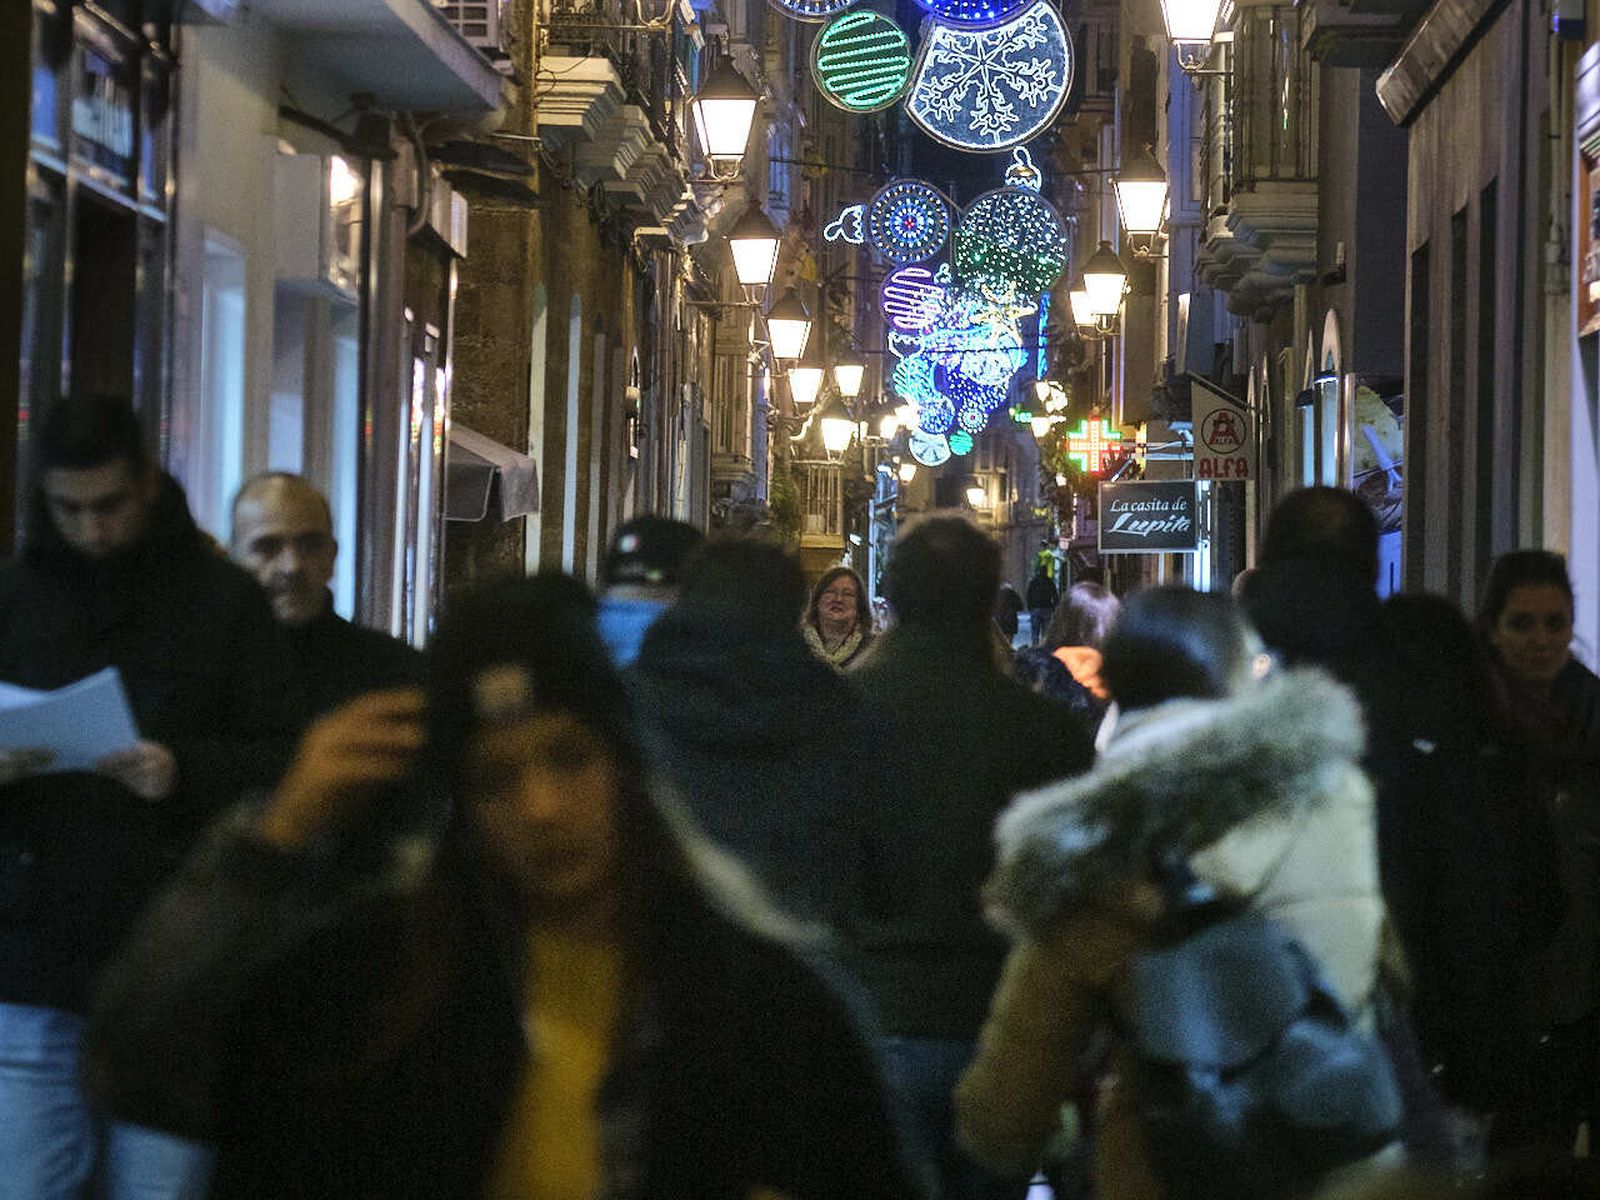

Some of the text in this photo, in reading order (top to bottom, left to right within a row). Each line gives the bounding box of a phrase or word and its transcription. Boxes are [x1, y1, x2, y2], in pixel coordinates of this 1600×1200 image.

[1199, 457, 1248, 478] ALFA
[1110, 496, 1187, 512] La casita de
[1108, 512, 1191, 537] Lupita
